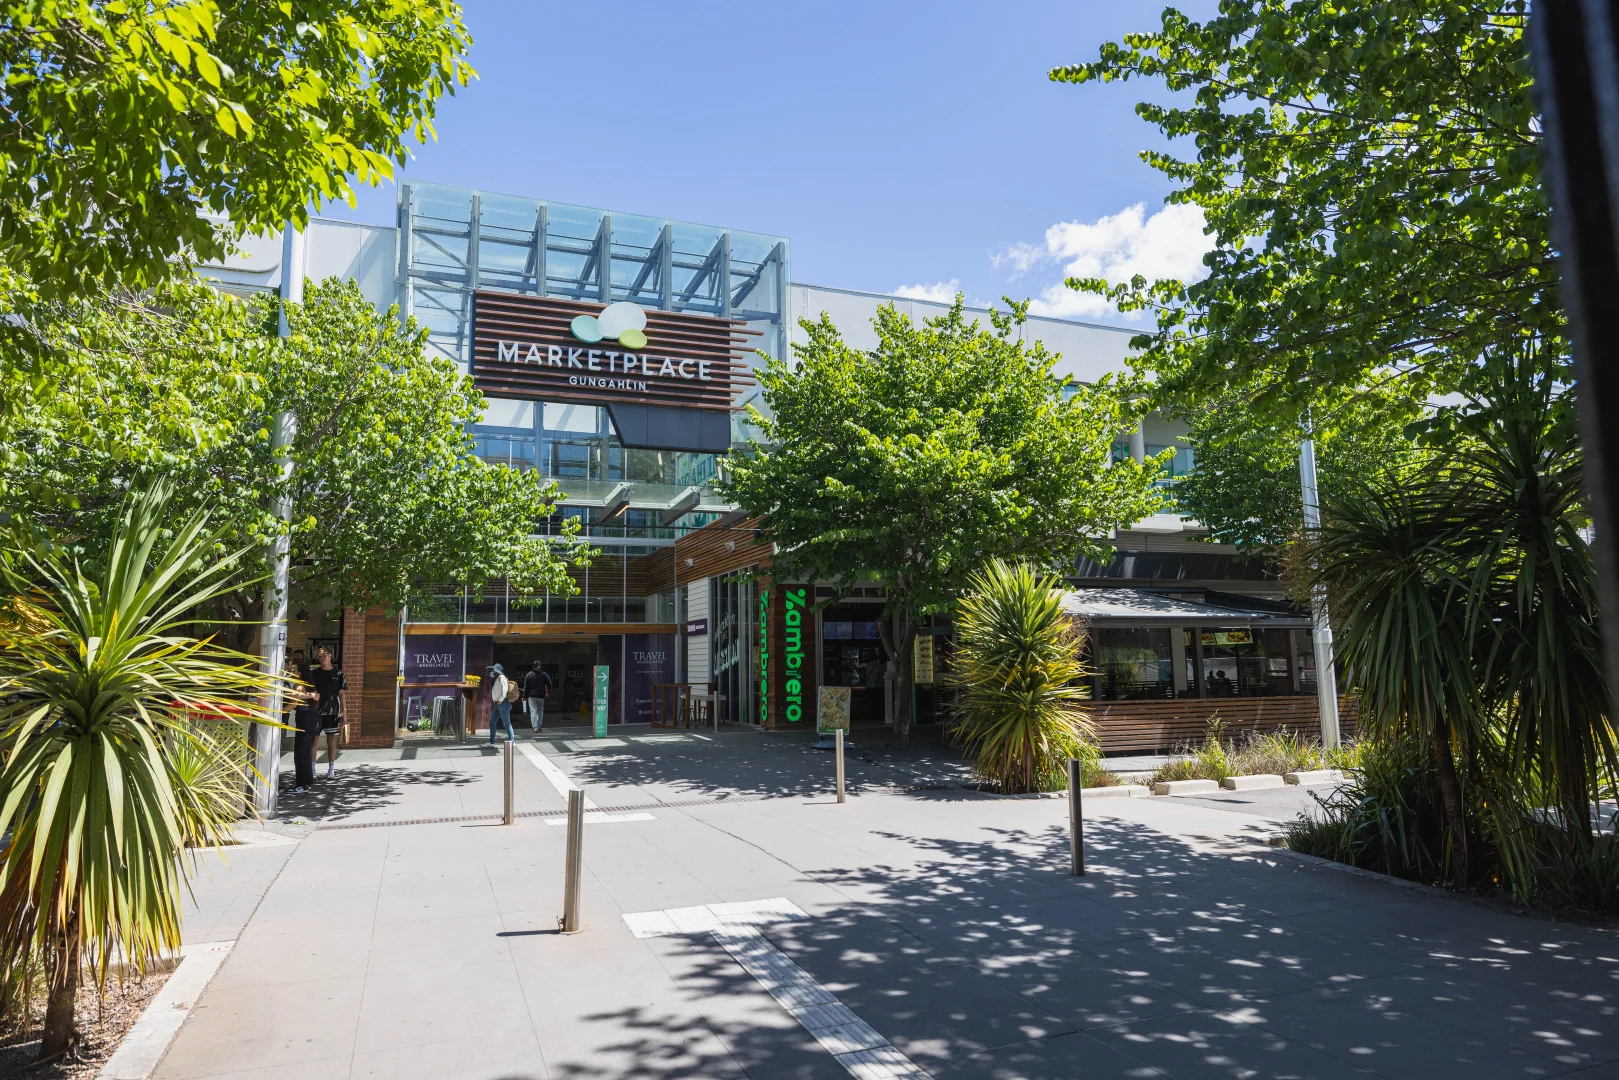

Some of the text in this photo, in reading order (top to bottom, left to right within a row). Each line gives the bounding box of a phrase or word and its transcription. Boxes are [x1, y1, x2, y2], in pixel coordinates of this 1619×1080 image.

[497, 340, 712, 381] MARKETPLACE
[569, 375, 647, 391] GUNGAHLIN
[414, 653, 455, 664] TRAVEL
[632, 651, 668, 661] TRAVEL
[568, 669, 585, 679] SALE
[602, 686, 607, 698] 1
